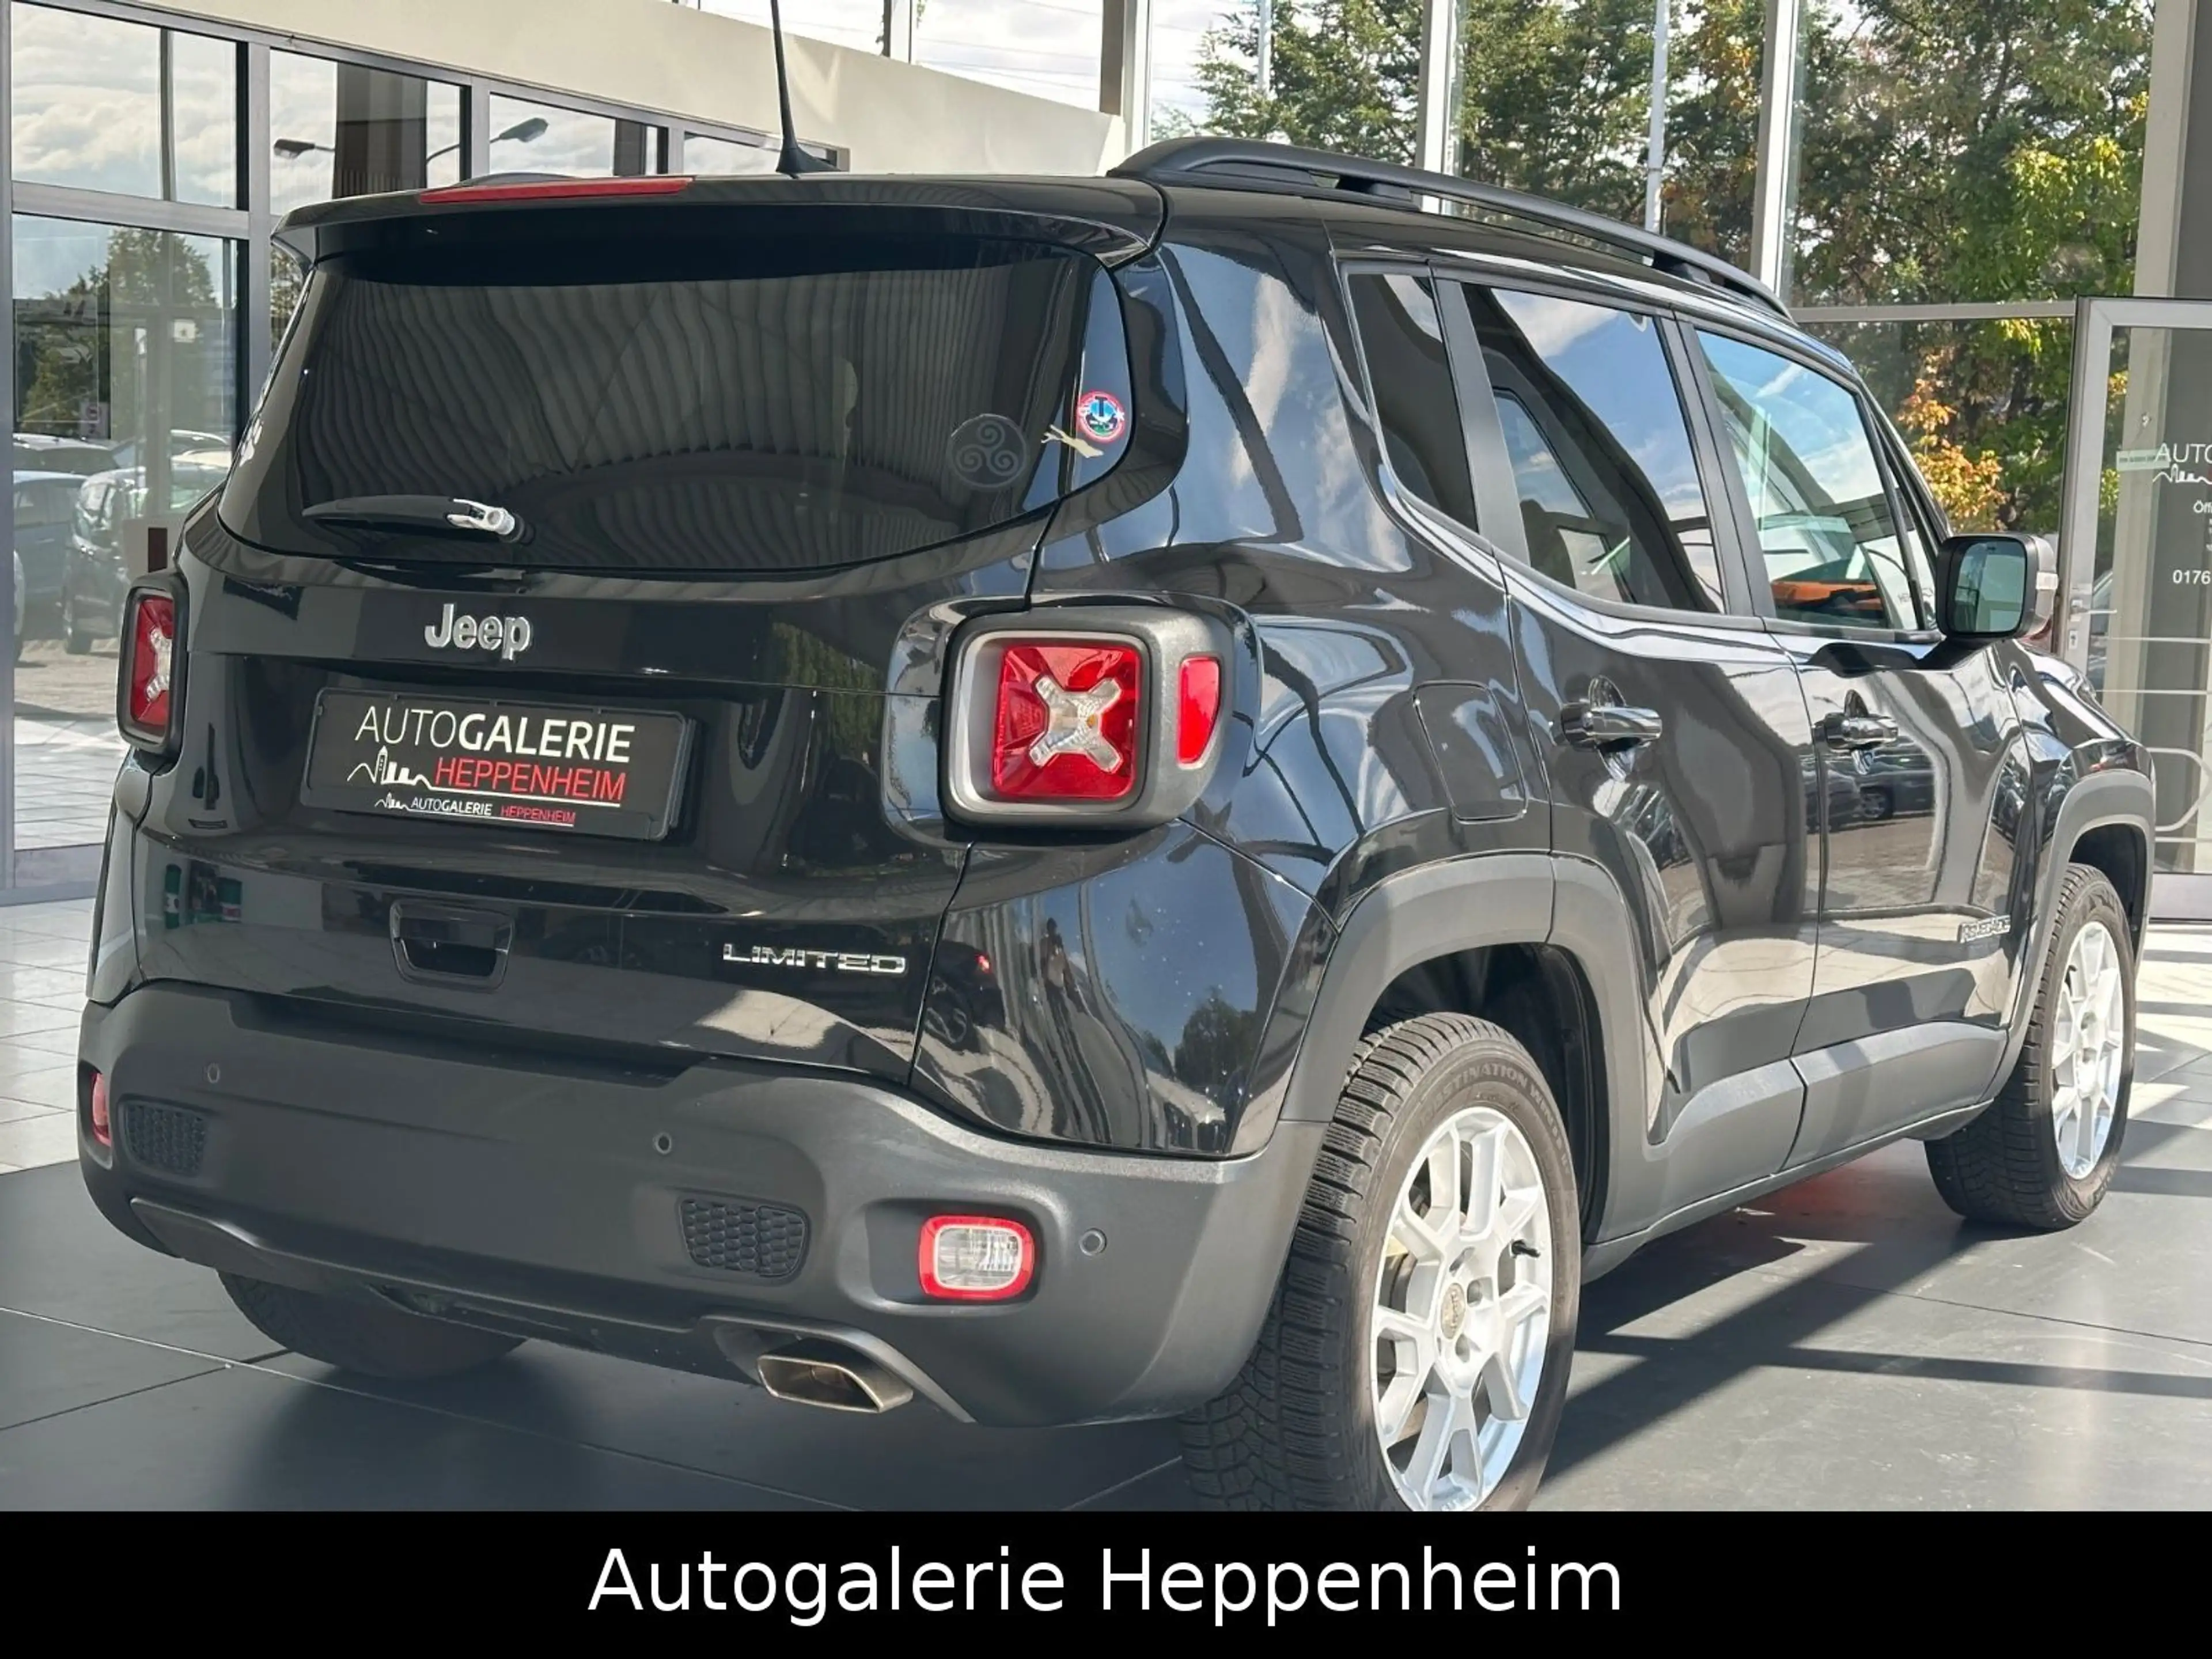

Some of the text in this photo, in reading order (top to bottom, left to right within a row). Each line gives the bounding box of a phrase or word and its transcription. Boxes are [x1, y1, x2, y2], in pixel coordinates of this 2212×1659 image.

[2172, 569, 2211, 585] 0176
[424, 603, 533, 661] Jeep
[354, 705, 635, 763] AUTOGALERIE
[434, 756, 627, 801] HEPPENHEIM
[410, 796, 576, 823] AUTOGALERIE HEPPENHEIM
[722, 942, 907, 974] LIMITED
